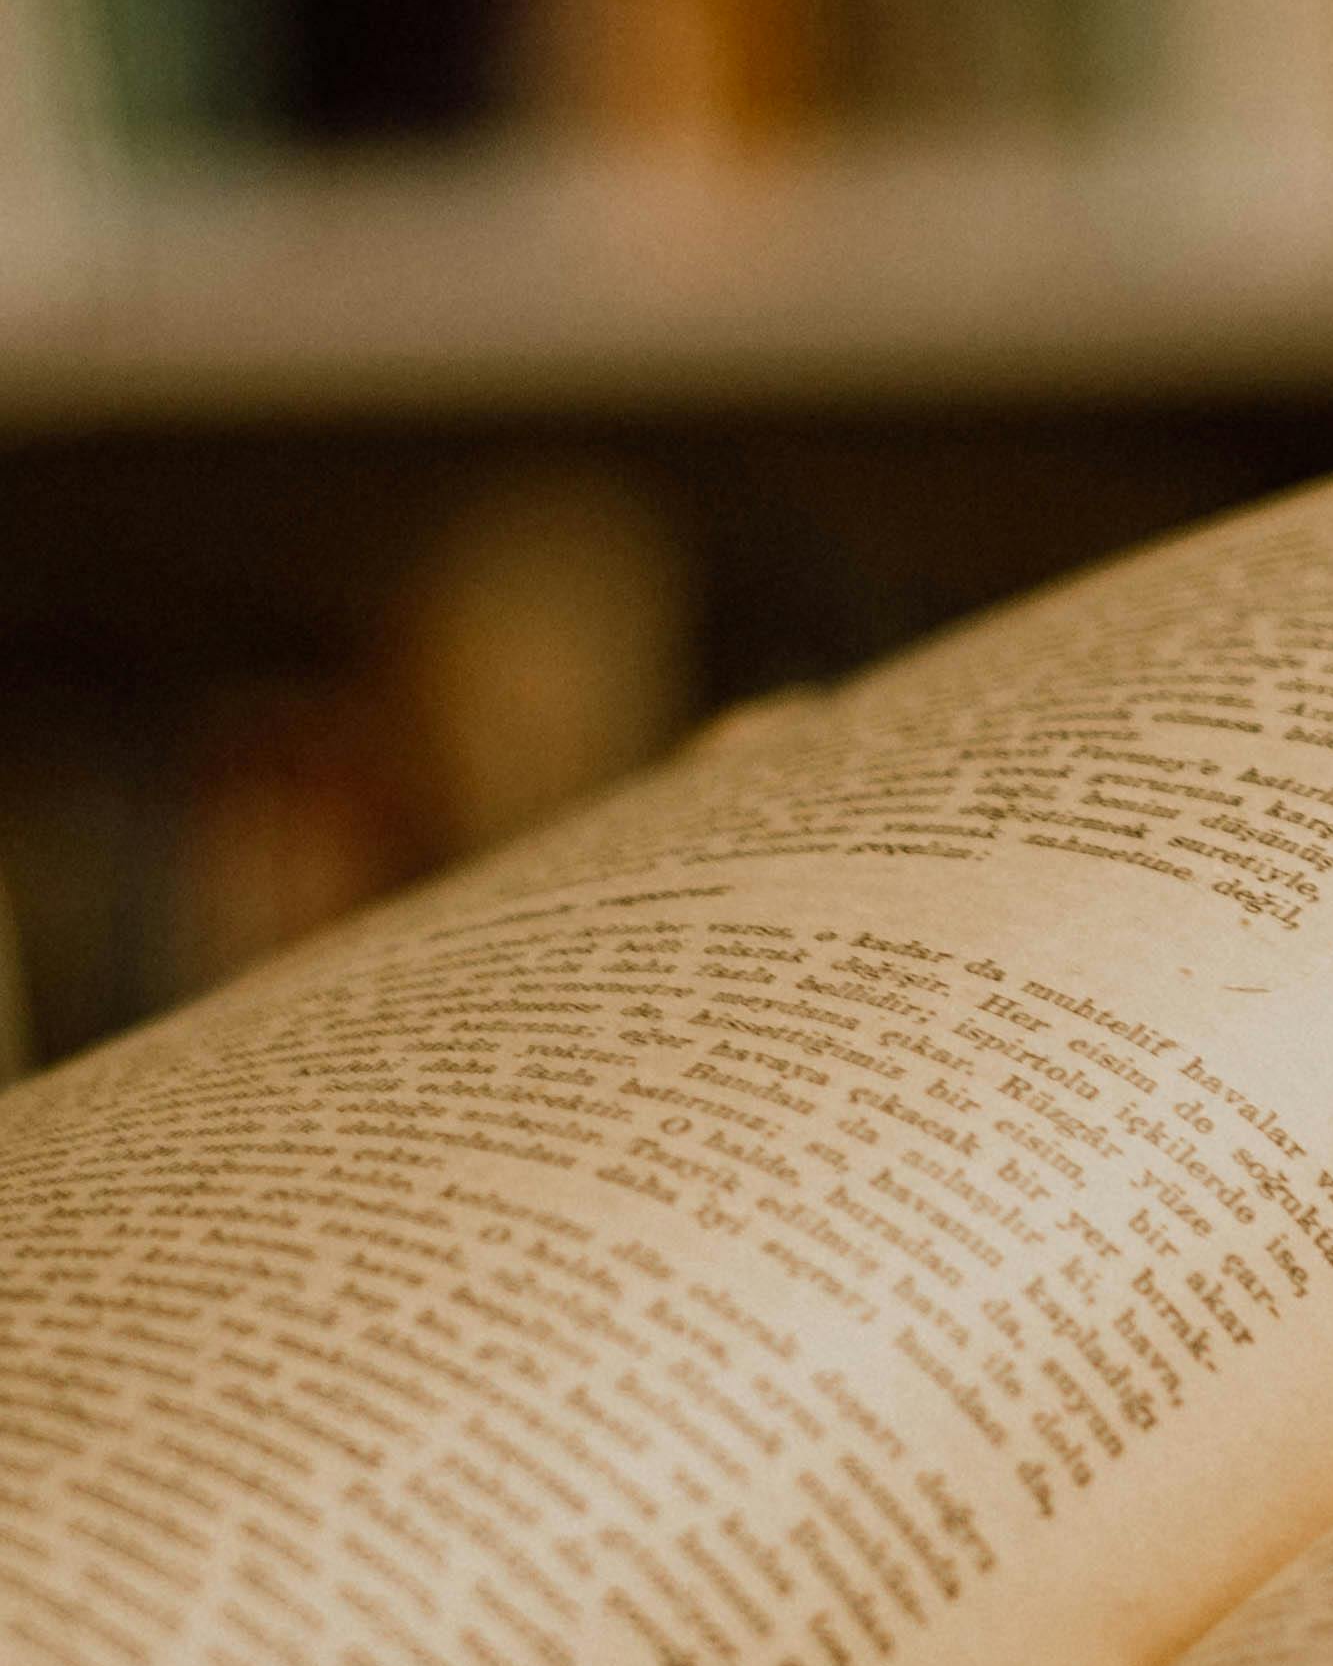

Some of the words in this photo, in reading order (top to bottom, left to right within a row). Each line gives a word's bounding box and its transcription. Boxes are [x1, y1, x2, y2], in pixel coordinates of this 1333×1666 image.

[1167, 836, 1319, 902] suretiyle,
[1211, 880, 1303, 929] değil,
[924, 1078, 983, 1112] bir
[975, 995, 1050, 1032] Her
[1067, 1038, 1157, 1094] cisim
[1173, 1100, 1215, 1135] de
[1021, 982, 1180, 1055] muhtelif
[1178, 1057, 1307, 1157] havalar
[952, 1019, 1098, 1099] ispirtolu
[1114, 1102, 1255, 1223] içkilerde
[1263, 1235, 1309, 1299] ise,
[997, 1159, 1051, 1199] bir
[1056, 1211, 1120, 1256] yer
